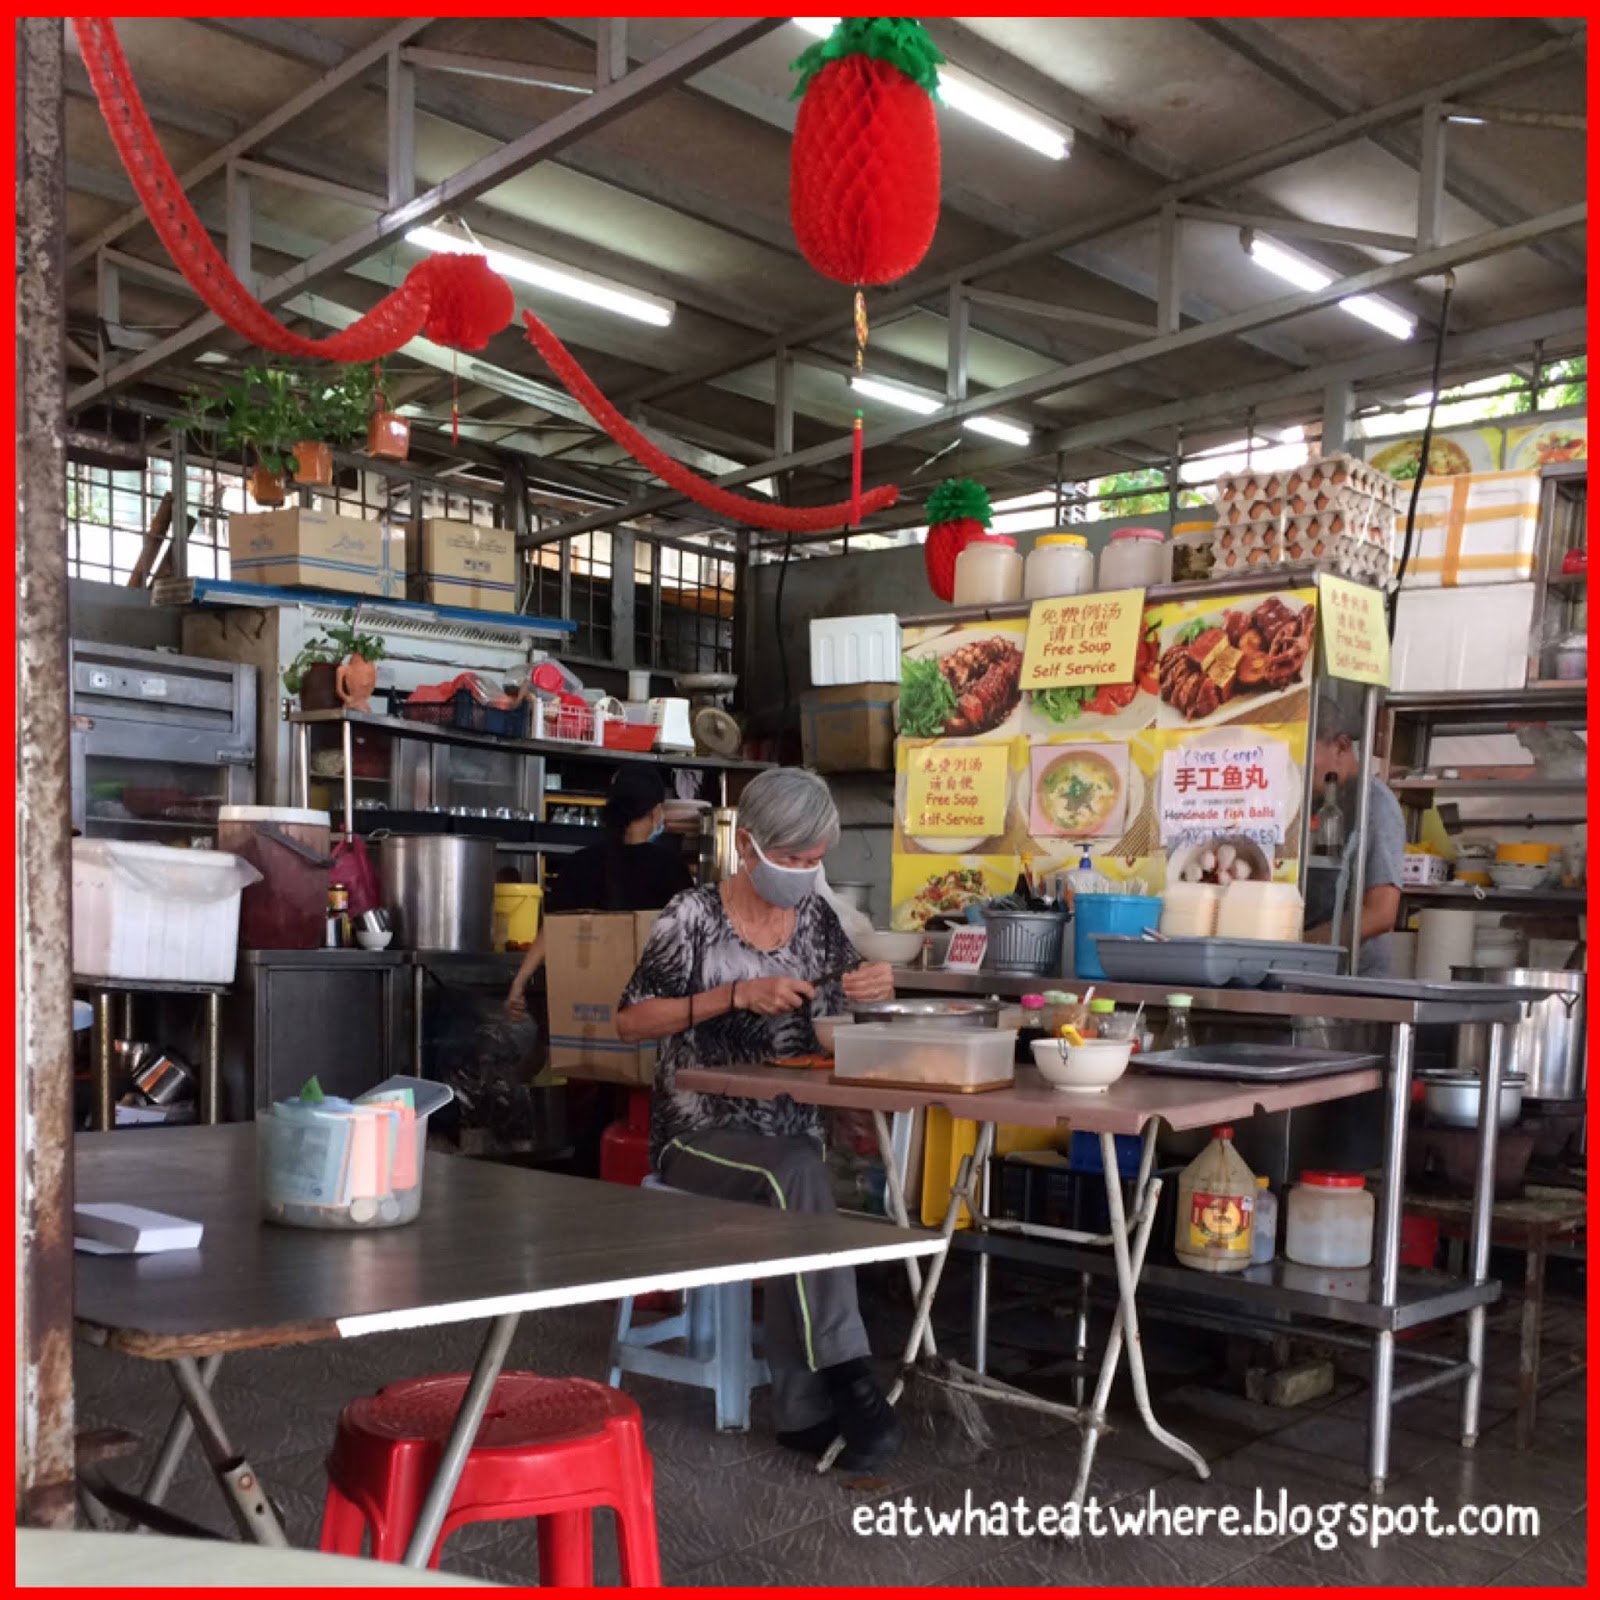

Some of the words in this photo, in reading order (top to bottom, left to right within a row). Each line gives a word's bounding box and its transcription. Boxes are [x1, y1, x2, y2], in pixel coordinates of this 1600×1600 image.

[1043, 642, 1074, 656] Free
[1078, 640, 1111, 655] Soup
[1032, 662, 1061, 678] Self
[1065, 660, 1116, 676] Service
[1174, 764, 1268, 793] 手工鱼丸
[926, 793, 950, 806] Free
[953, 793, 979, 808] Soup
[1164, 809, 1219, 820] Handmade
[1249, 806, 1275, 818] Balls
